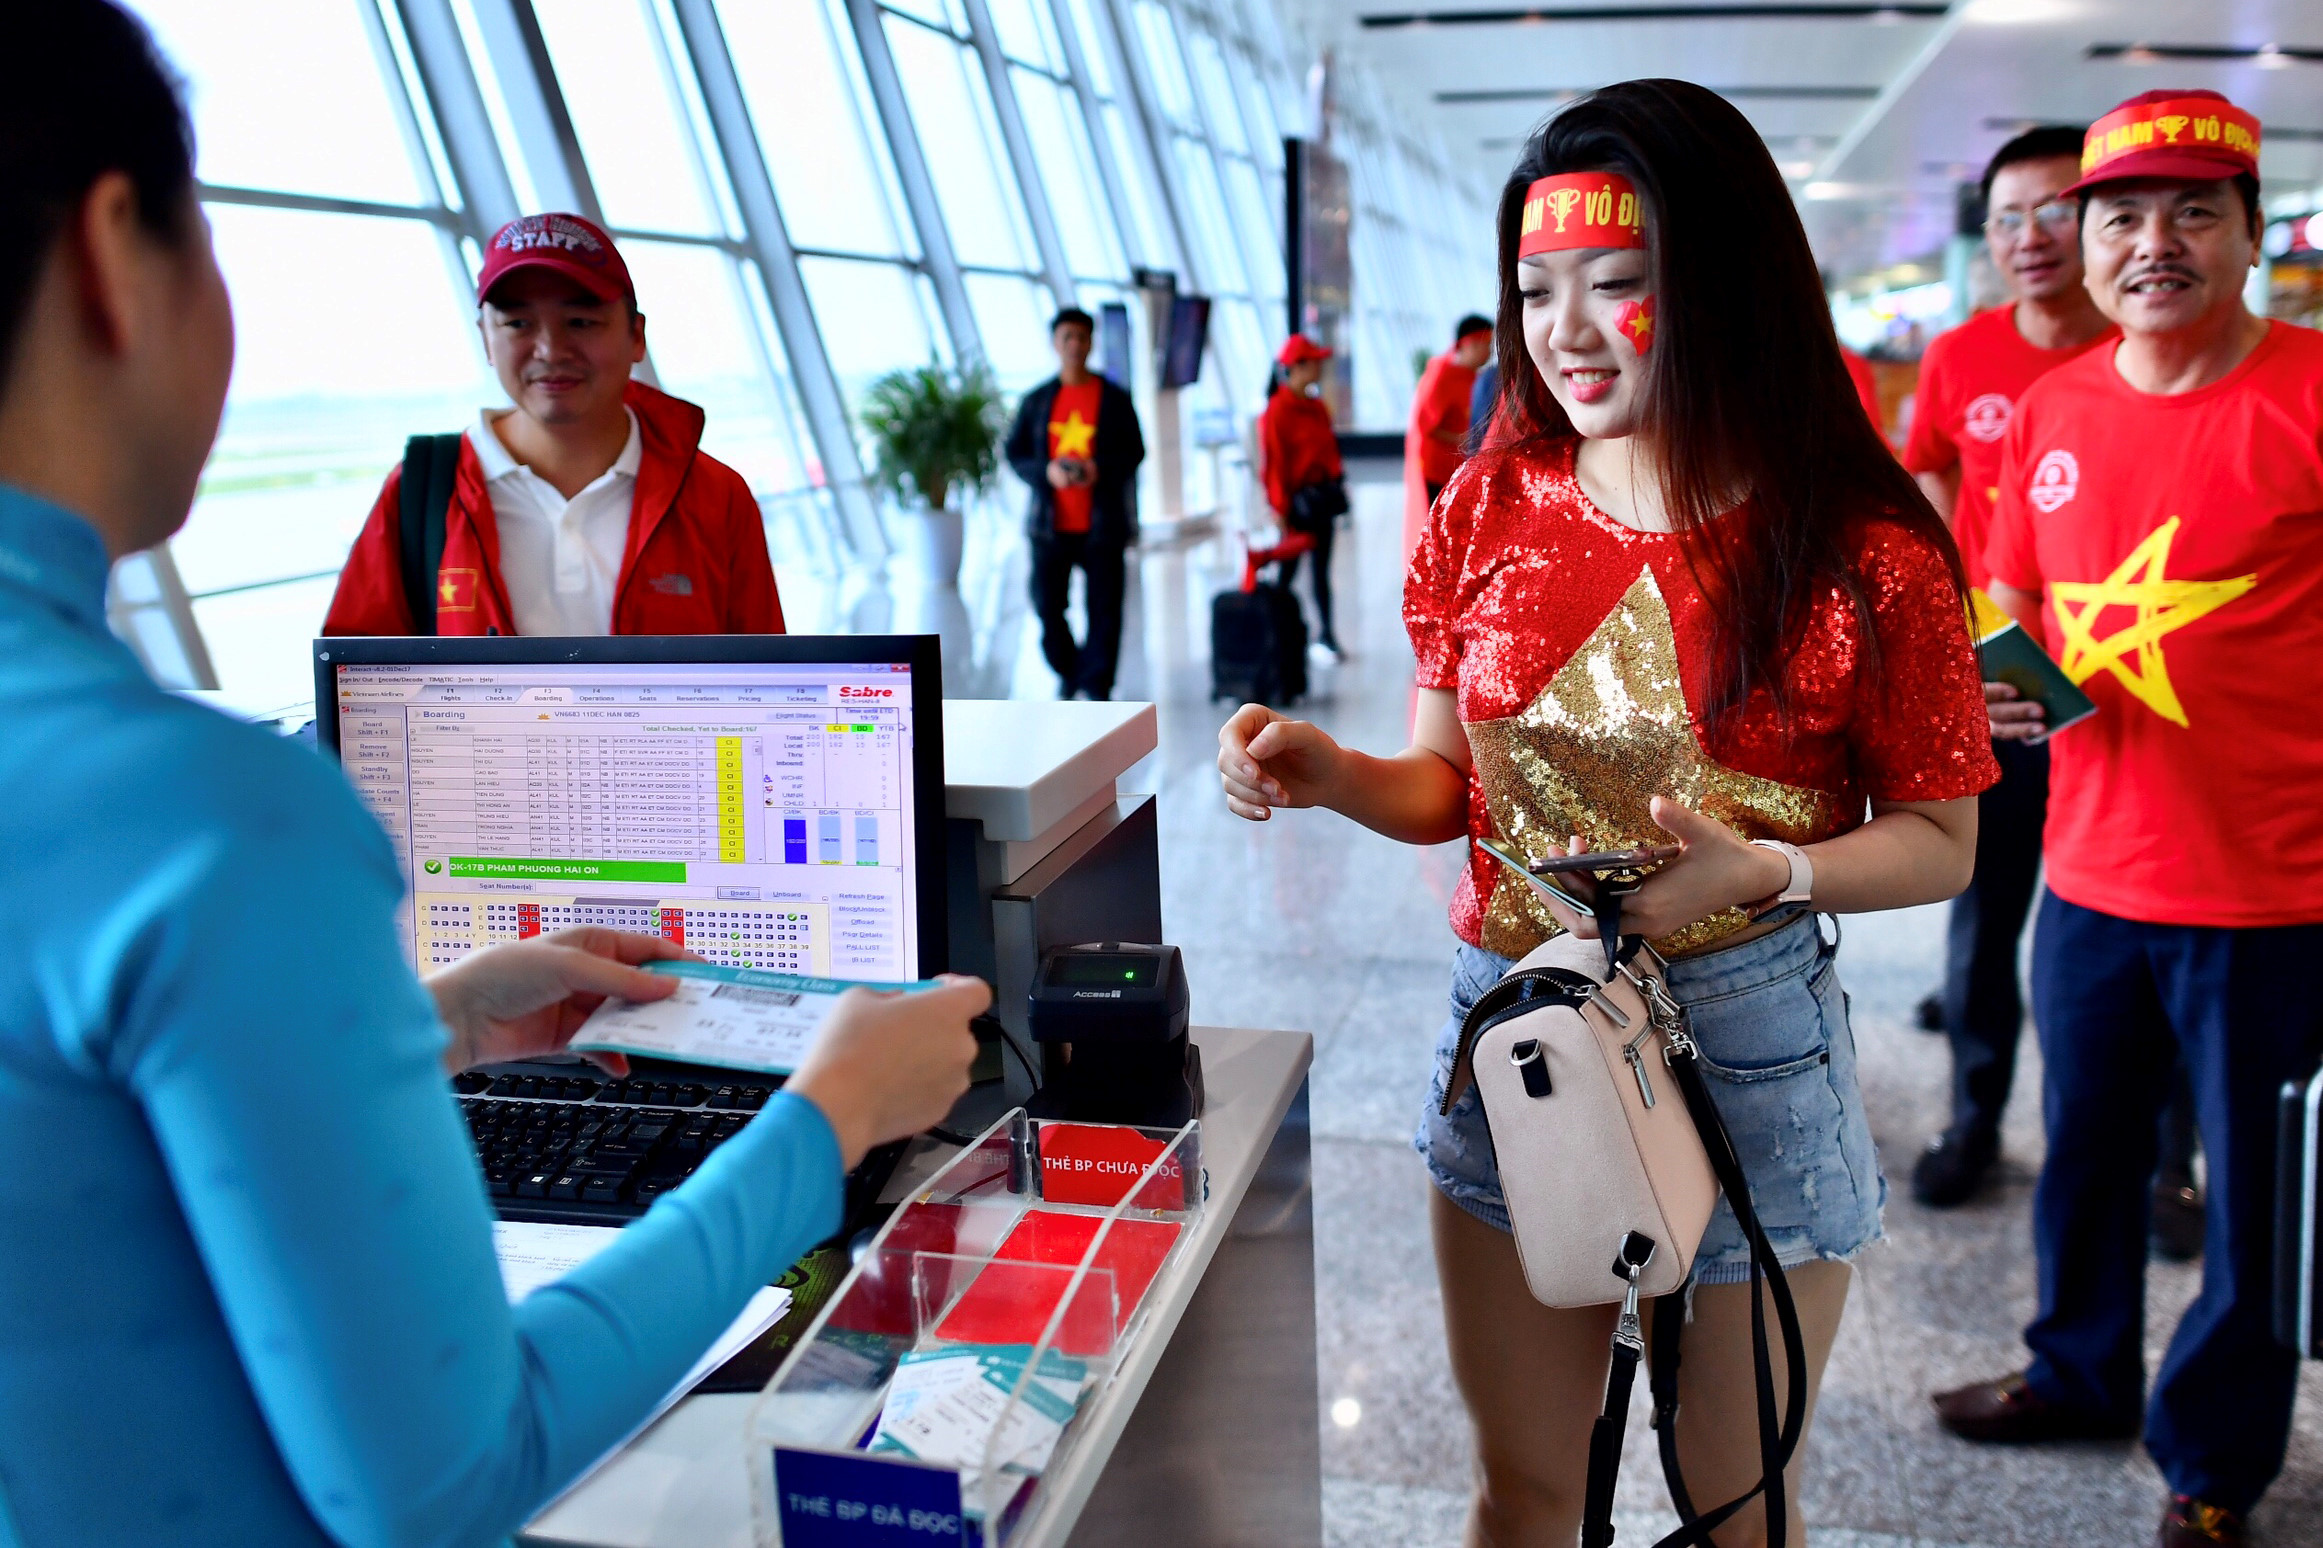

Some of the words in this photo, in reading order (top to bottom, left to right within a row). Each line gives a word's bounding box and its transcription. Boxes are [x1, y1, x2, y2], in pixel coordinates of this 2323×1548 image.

[2107, 121, 2153, 152] NAM
[2194, 115, 2220, 141] VÔ
[1585, 184, 1612, 226] VÔ
[511, 231, 580, 252] STAFF
[839, 686, 893, 698] Sabre
[423, 711, 465, 719] Boarding
[449, 863, 485, 871] OK-17B
[487, 864, 516, 872] PHAM
[518, 865, 562, 873] PHUONG
[564, 866, 581, 874] HAI
[584, 866, 599, 874] ON
[736, 969, 799, 990] Economy
[1043, 1155, 1072, 1171] THẺ
[1075, 1159, 1093, 1171] BP
[1096, 1161, 1138, 1175] CHƯA
[835, 1500, 868, 1521] BP
